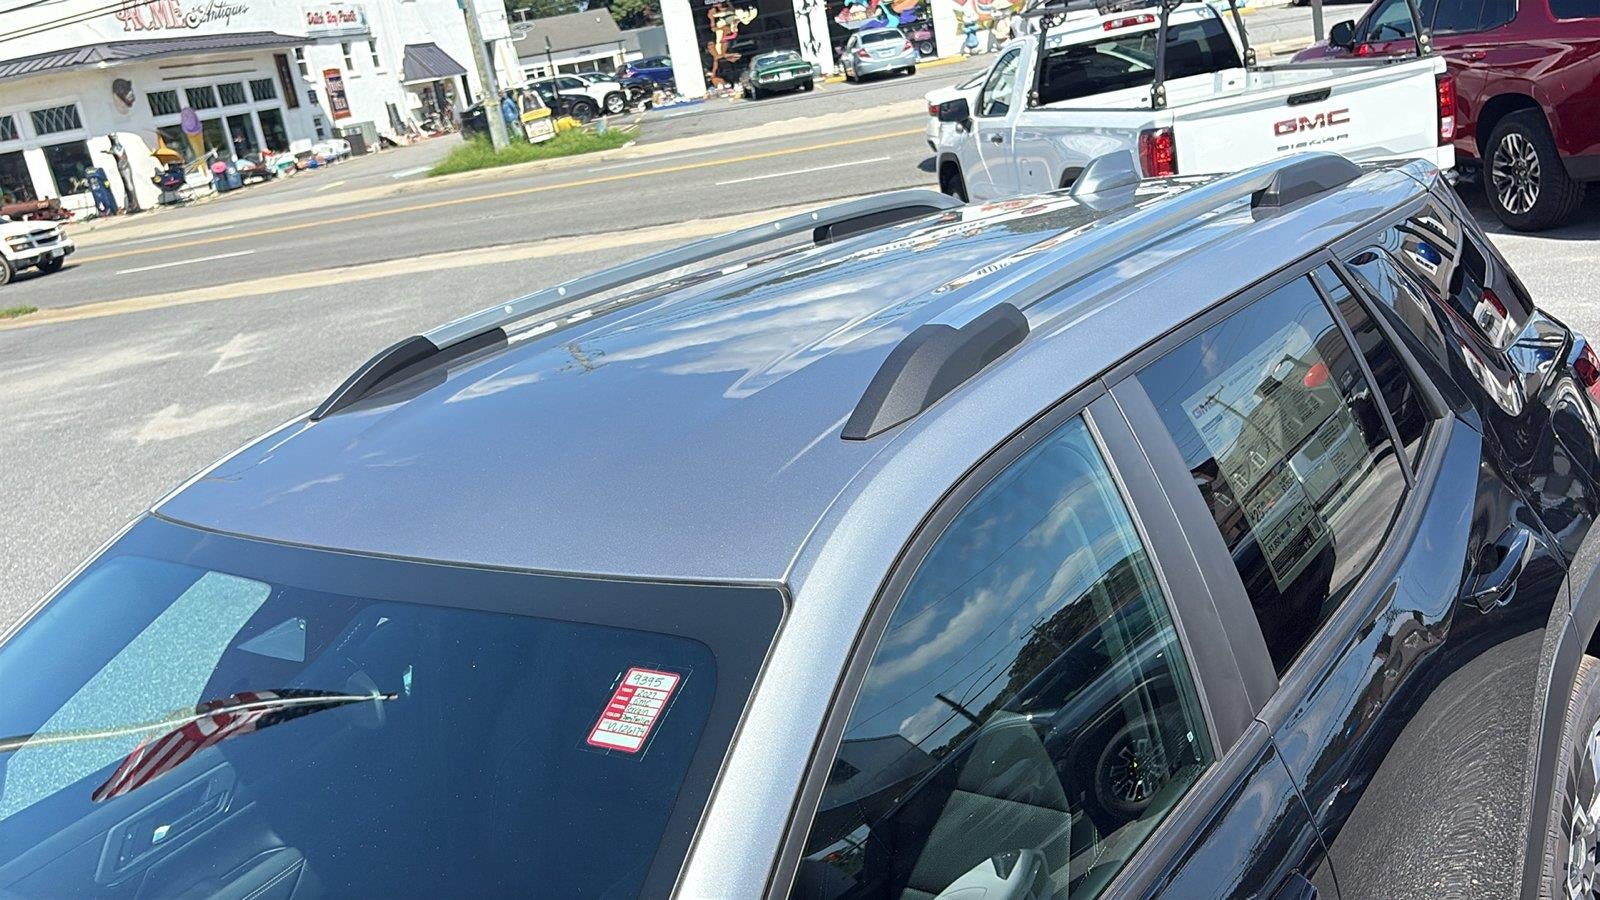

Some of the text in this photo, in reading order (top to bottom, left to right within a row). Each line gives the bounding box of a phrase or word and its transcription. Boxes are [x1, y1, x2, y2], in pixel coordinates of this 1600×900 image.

[115, 0, 187, 31] ACME
[202, 0, 249, 26] Antiques
[1273, 108, 1350, 137] GMC
[633, 673, 665, 688] 9395
